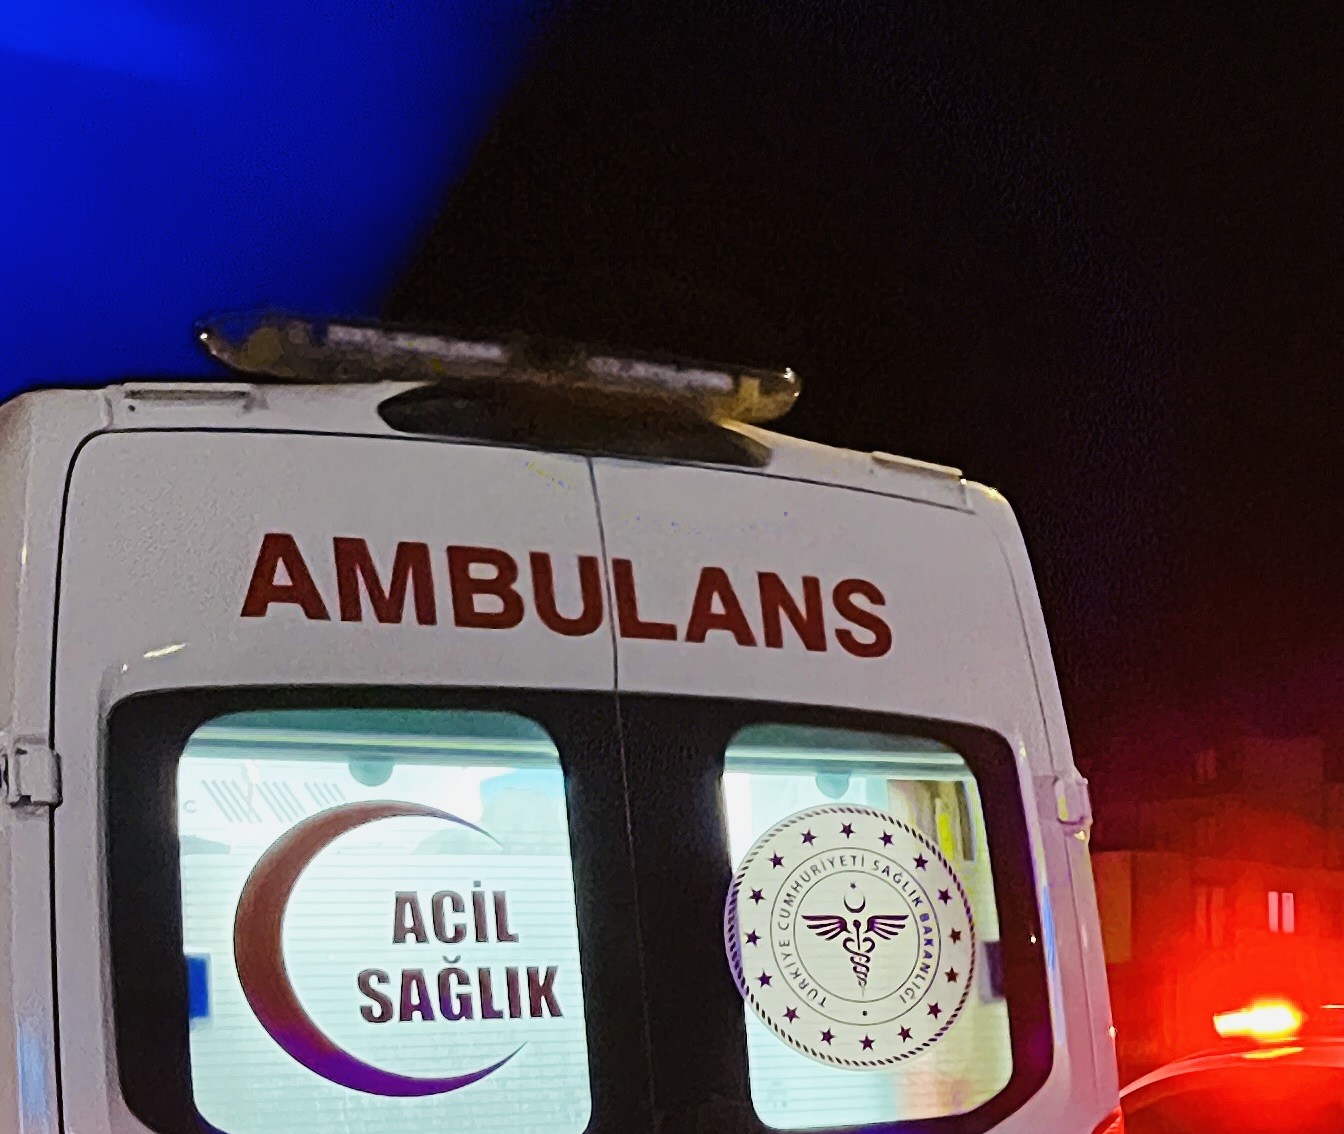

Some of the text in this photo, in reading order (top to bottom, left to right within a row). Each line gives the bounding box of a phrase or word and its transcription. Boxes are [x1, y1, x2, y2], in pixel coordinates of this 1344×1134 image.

[240, 532, 893, 657] AMBULANS
[392, 880, 519, 944] ACİL
[777, 854, 934, 1008] TÜRKİYE CUMHURİYETİ SAĞLIK BAKANLIĞI
[357, 955, 564, 1023] SAĞLIK
